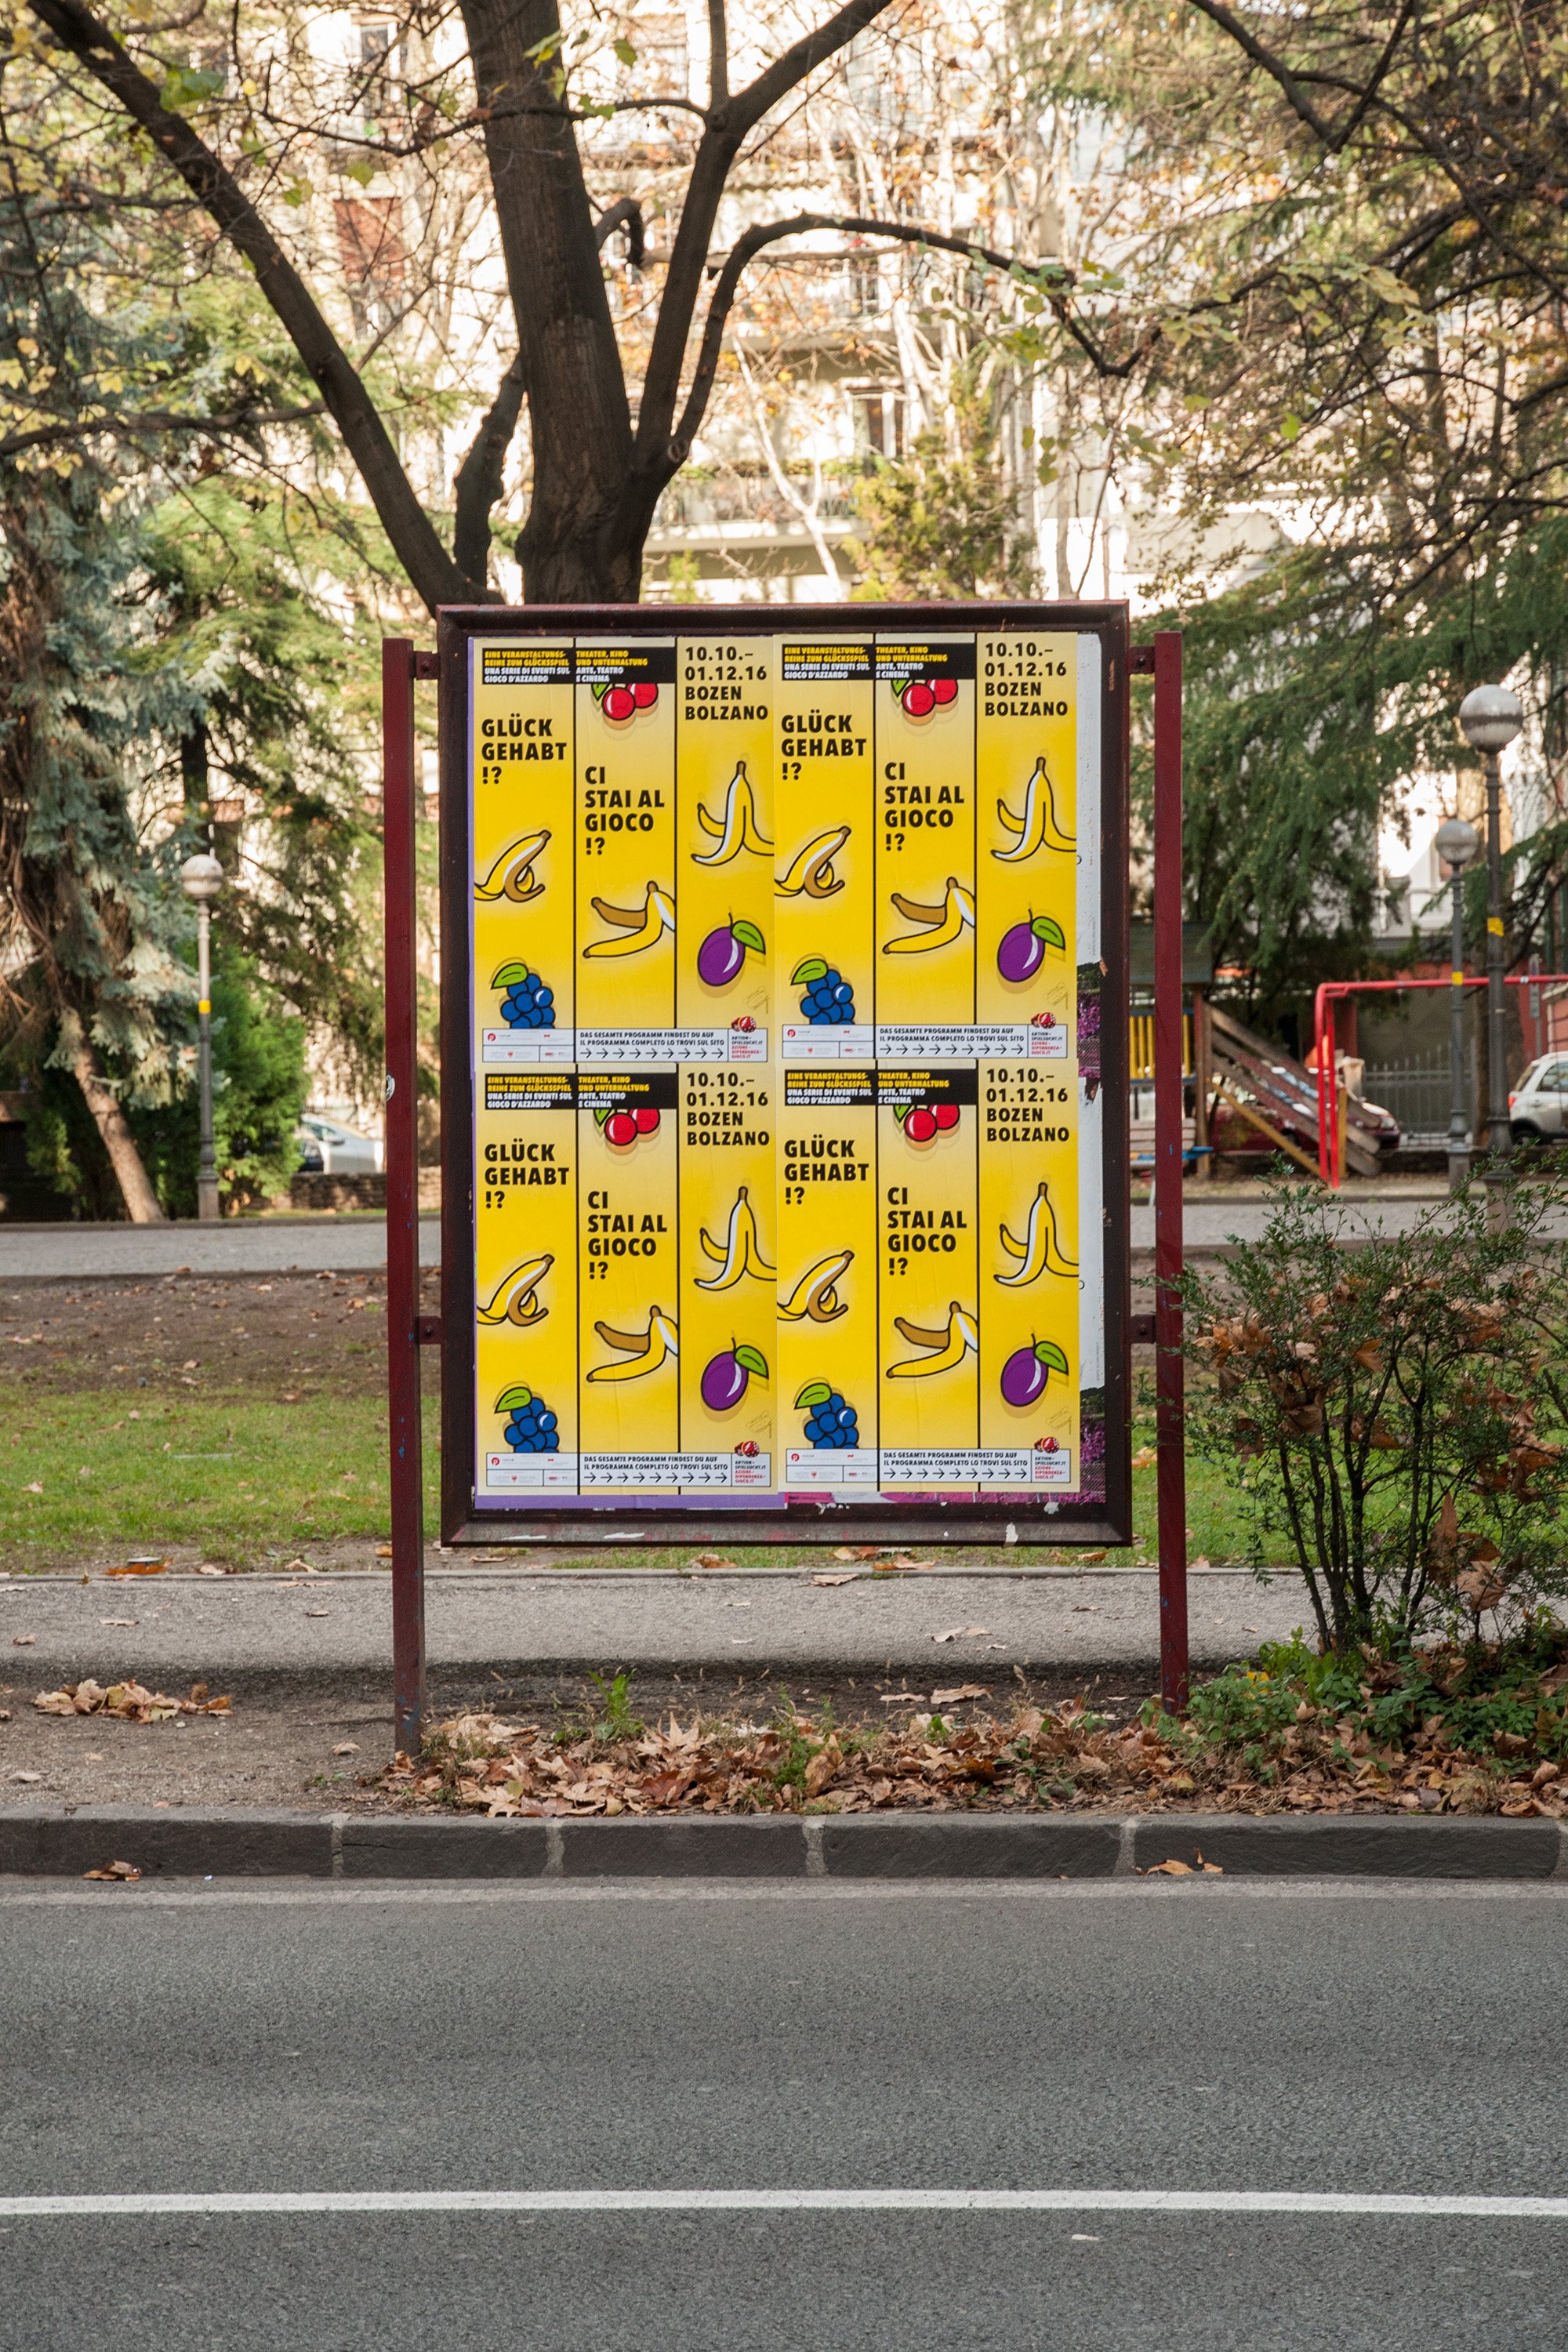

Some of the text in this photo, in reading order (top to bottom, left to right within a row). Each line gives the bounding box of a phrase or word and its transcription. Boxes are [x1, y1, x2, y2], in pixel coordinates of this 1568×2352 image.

[685, 666, 767, 681] 01.12.16
[985, 662, 1066, 677] 01.12.16
[685, 686, 742, 700] BOZEN
[985, 682, 1041, 696] BOZEN
[685, 706, 768, 720] BOLZANO
[985, 701, 1068, 716] BOLZANO
[481, 713, 552, 737] GLÜCK
[781, 709, 852, 733] GLÜCK
[481, 742, 566, 760] GEHABT
[781, 739, 866, 757] GEHABT
[483, 767, 502, 784] !?
[585, 766, 605, 784] CI
[782, 762, 801, 780] !?
[884, 762, 905, 780] CI
[585, 789, 665, 808] STAI AL
[884, 786, 964, 804] STAI AL
[585, 813, 654, 831] GIOCO
[884, 809, 953, 827] GIOCO
[586, 837, 605, 855] !?
[886, 833, 905, 851] !?
[687, 1091, 768, 1106] 01.12.16
[987, 1087, 1068, 1102] 01.12.16
[687, 1112, 742, 1126] BOZEN
[987, 1108, 1043, 1122] BOZEN
[687, 1131, 770, 1145] BOLZANO
[987, 1127, 1069, 1142] BOLZANO
[485, 1138, 555, 1162] GLÜCK
[784, 1134, 855, 1158] GLÜCK
[485, 1167, 569, 1185] GEHABT
[784, 1163, 869, 1181] GEHABT
[485, 1191, 505, 1209] !?
[587, 1191, 608, 1209] CI
[786, 1187, 804, 1204] !?
[887, 1187, 907, 1205] CI
[588, 1214, 667, 1232] STAI AL
[887, 1210, 967, 1229] STAI AL
[588, 1238, 656, 1256] GIOCO
[887, 1234, 956, 1252] GIOCO
[589, 1261, 608, 1279] !?
[889, 1258, 908, 1276] !?
